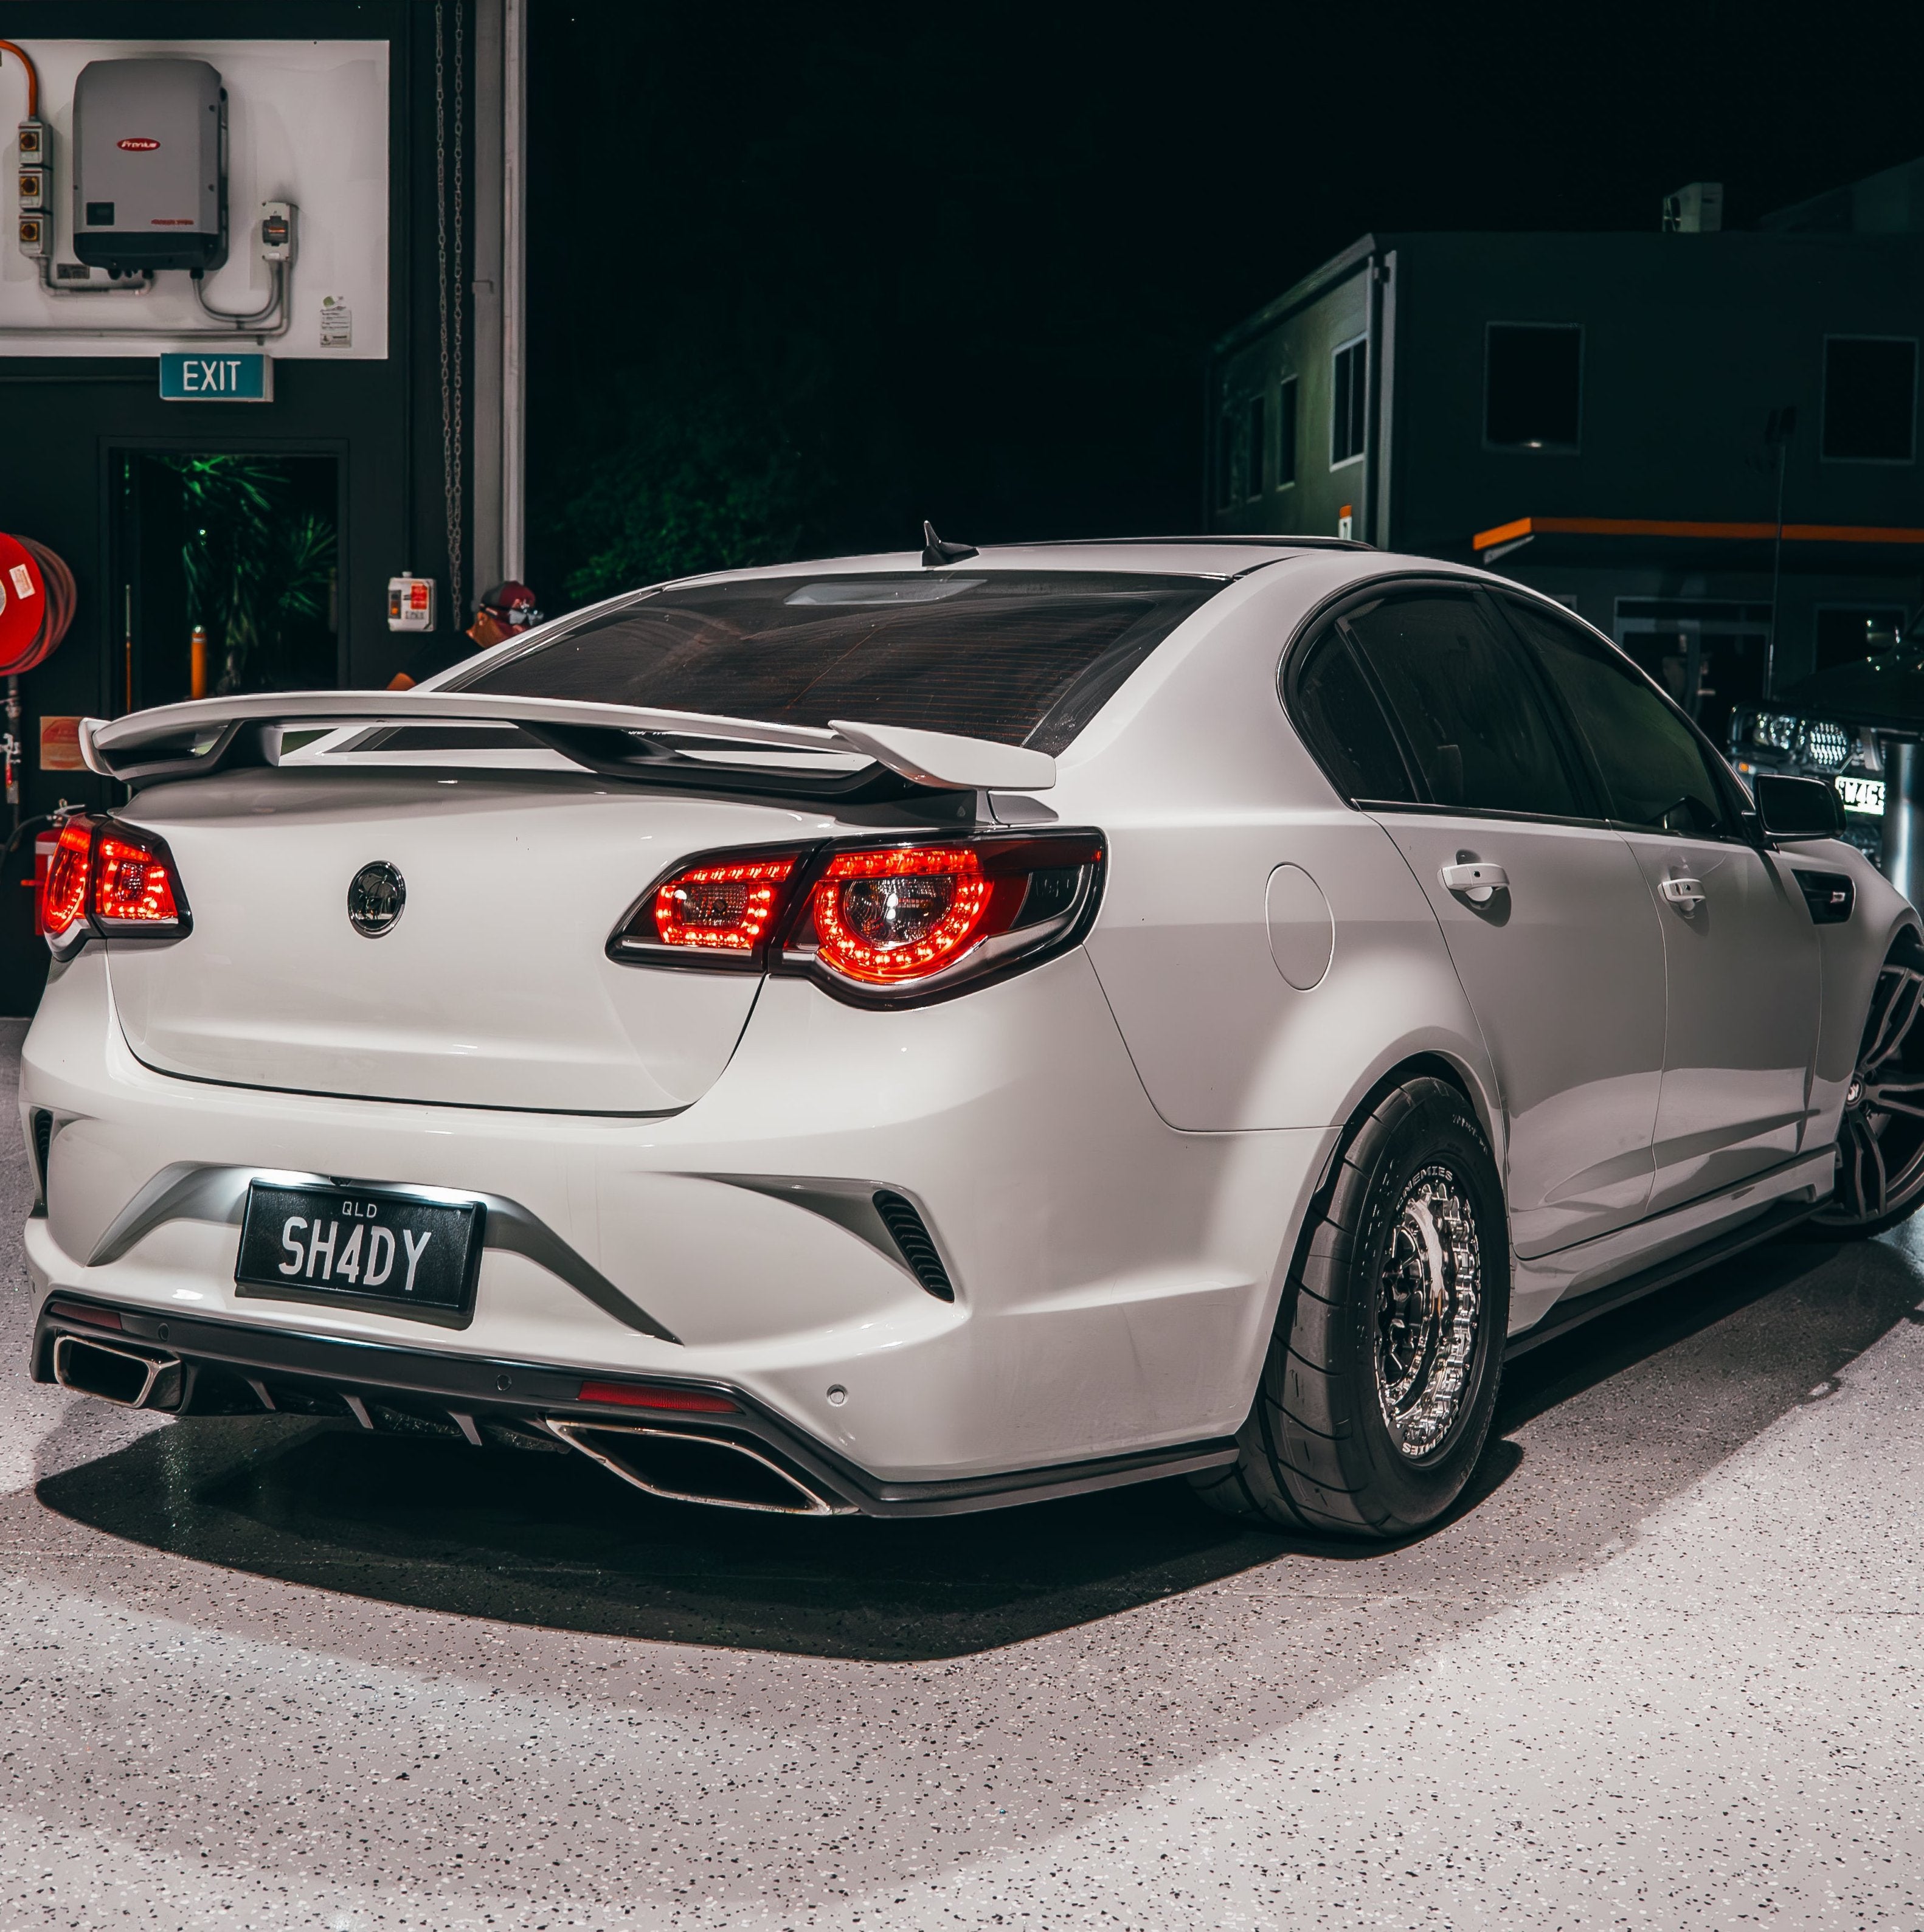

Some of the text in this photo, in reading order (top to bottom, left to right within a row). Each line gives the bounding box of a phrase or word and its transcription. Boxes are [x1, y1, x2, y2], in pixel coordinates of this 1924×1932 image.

[183, 361, 241, 391] EXIT
[342, 1201, 377, 1219] QLD
[278, 1216, 432, 1291] SH4DY
